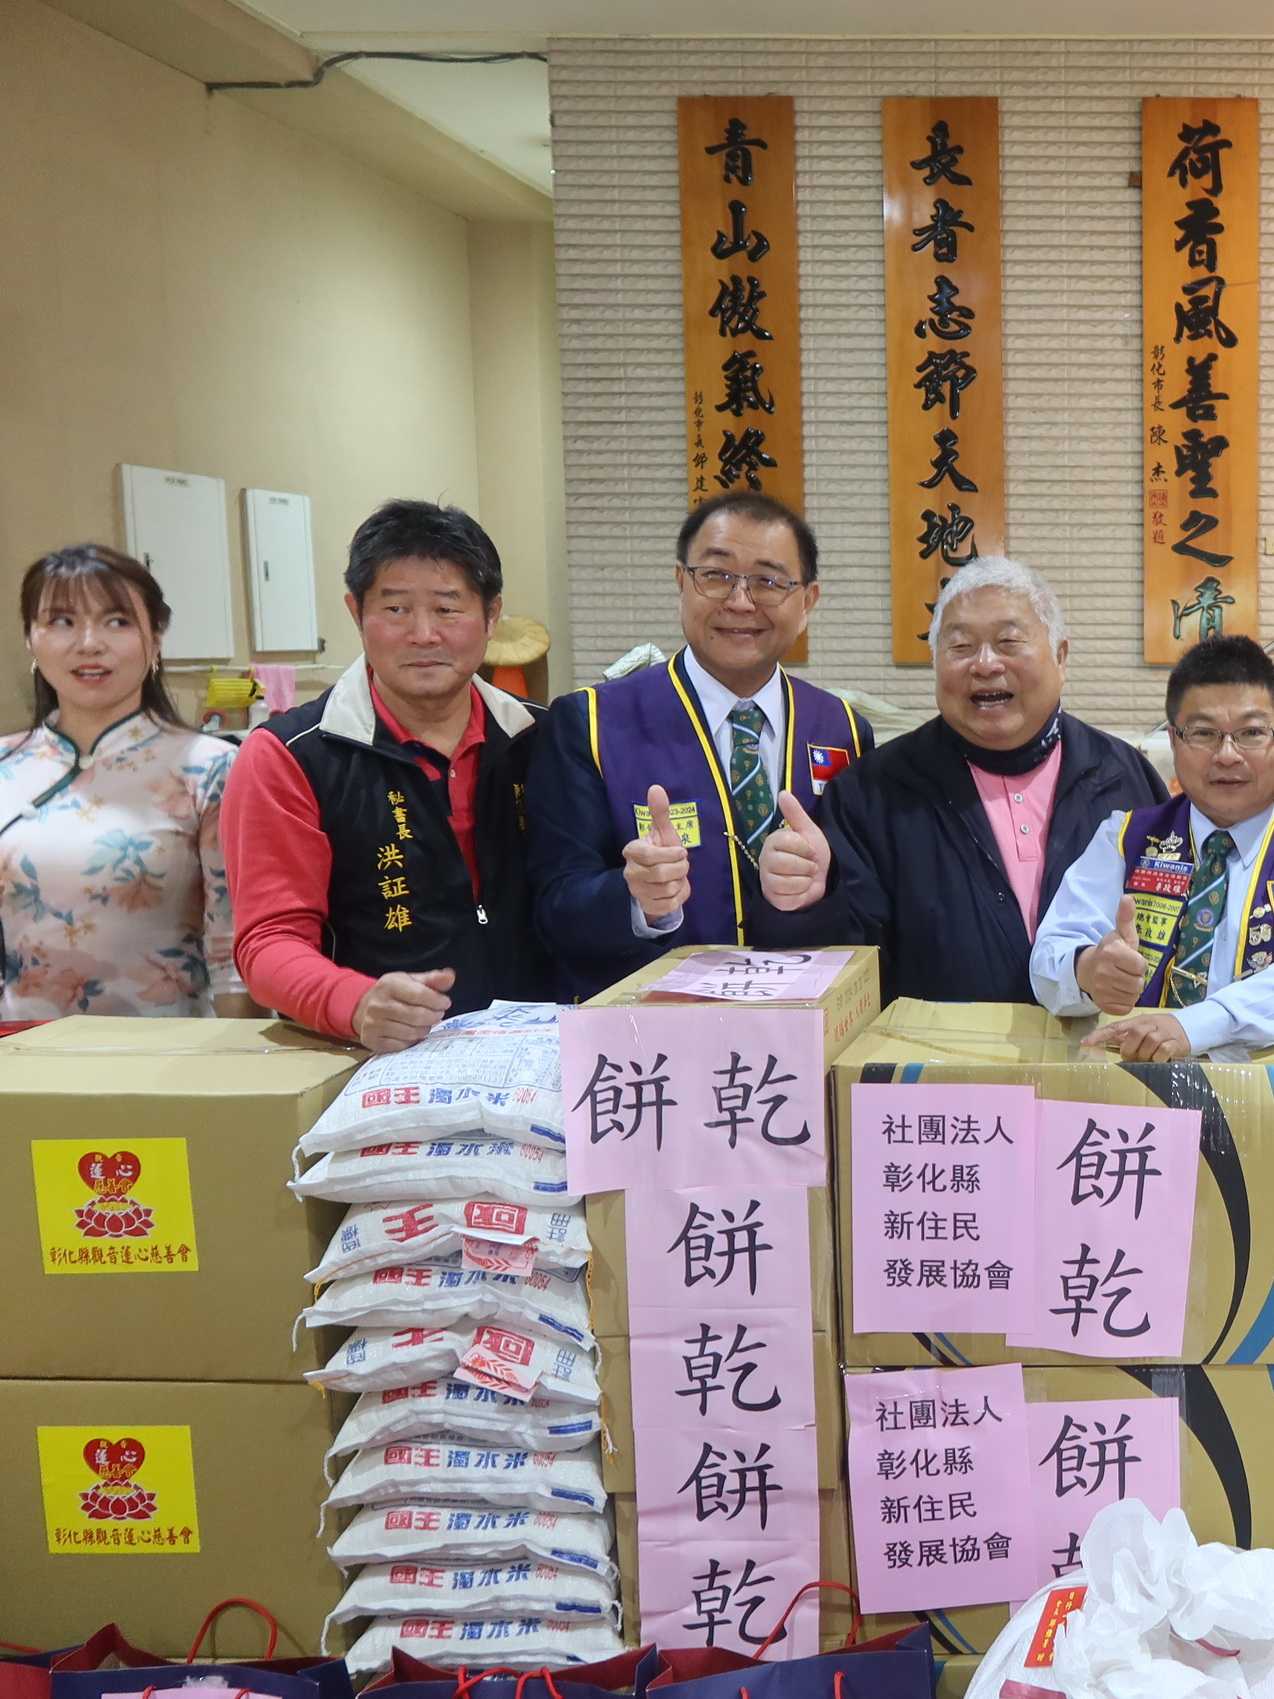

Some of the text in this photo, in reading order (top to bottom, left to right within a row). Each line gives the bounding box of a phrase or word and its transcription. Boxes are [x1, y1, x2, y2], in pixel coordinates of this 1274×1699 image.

[911, 119, 979, 643] 長者志節天地
[387, 790, 413, 840] 秘書長
[1154, 861, 1188, 872] Kiwanis
[376, 843, 413, 933] 洪証雄
[570, 1051, 812, 1152] 餅乾
[881, 1113, 1015, 1146] 社團法人
[89, 1163, 133, 1179] 蓮心
[882, 1162, 982, 1195] 彰化縣
[882, 1209, 982, 1243] 新住民
[1048, 1117, 1163, 1338] 餅乾
[49, 1243, 192, 1266] 彰化縣觀音蓮心慈善會
[882, 1258, 1014, 1291] 發展協會
[666, 1199, 782, 1417] 餅乾
[875, 1394, 1004, 1433] 社團法人
[94, 1448, 138, 1464] 蓮心
[384, 1446, 441, 1468] 國王
[447, 1450, 529, 1469] 濁水米
[875, 1444, 975, 1481] 彰化縣
[385, 1510, 441, 1531] 國王
[446, 1511, 531, 1531] 濁水米
[879, 1491, 979, 1525] 新住民
[54, 1526, 193, 1547] 彰化縣觀音蓮心慈善會
[677, 1442, 788, 1648] 餅乾
[883, 1531, 1014, 1571] 發展協會
[389, 1565, 446, 1588] 國王
[451, 1563, 532, 1590] 濁水米
[400, 1618, 455, 1640] 國王
[459, 1617, 542, 1640] 濁水米
